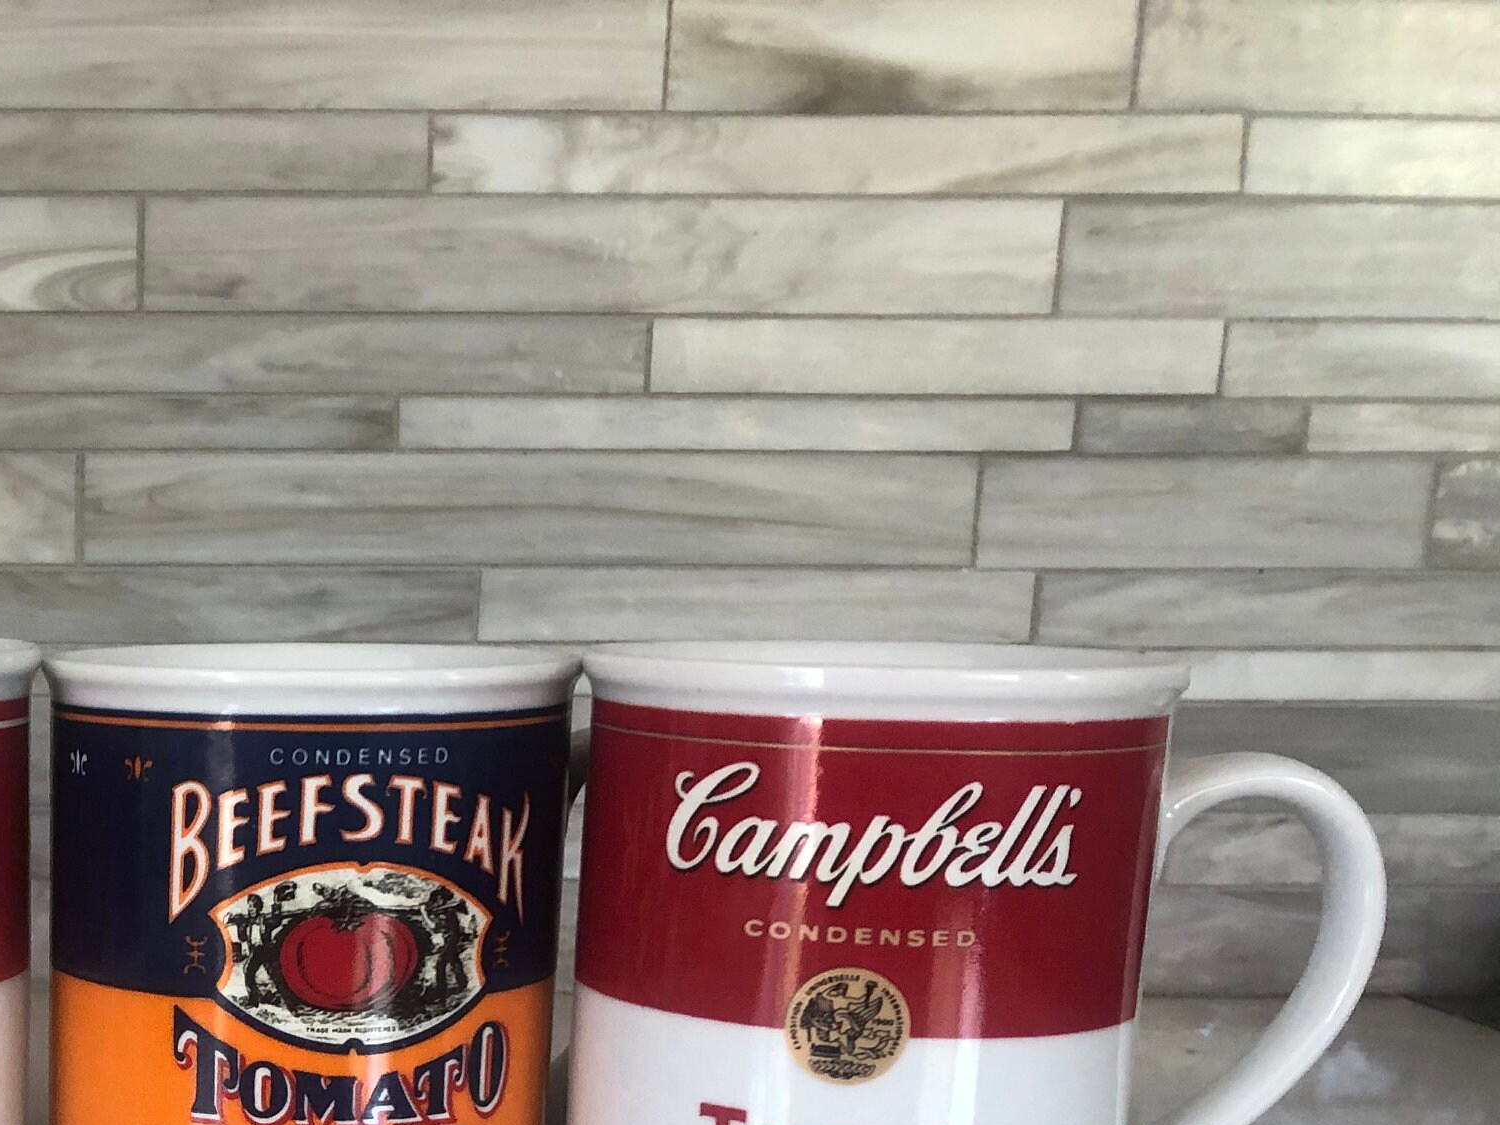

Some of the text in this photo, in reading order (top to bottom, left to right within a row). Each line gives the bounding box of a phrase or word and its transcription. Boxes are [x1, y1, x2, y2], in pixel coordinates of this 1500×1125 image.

[269, 747, 451, 767] CONDENSED
[168, 772, 531, 926] BEEFSTEAK
[665, 761, 1083, 909] Campbell's
[743, 918, 977, 949] CONDENSED
